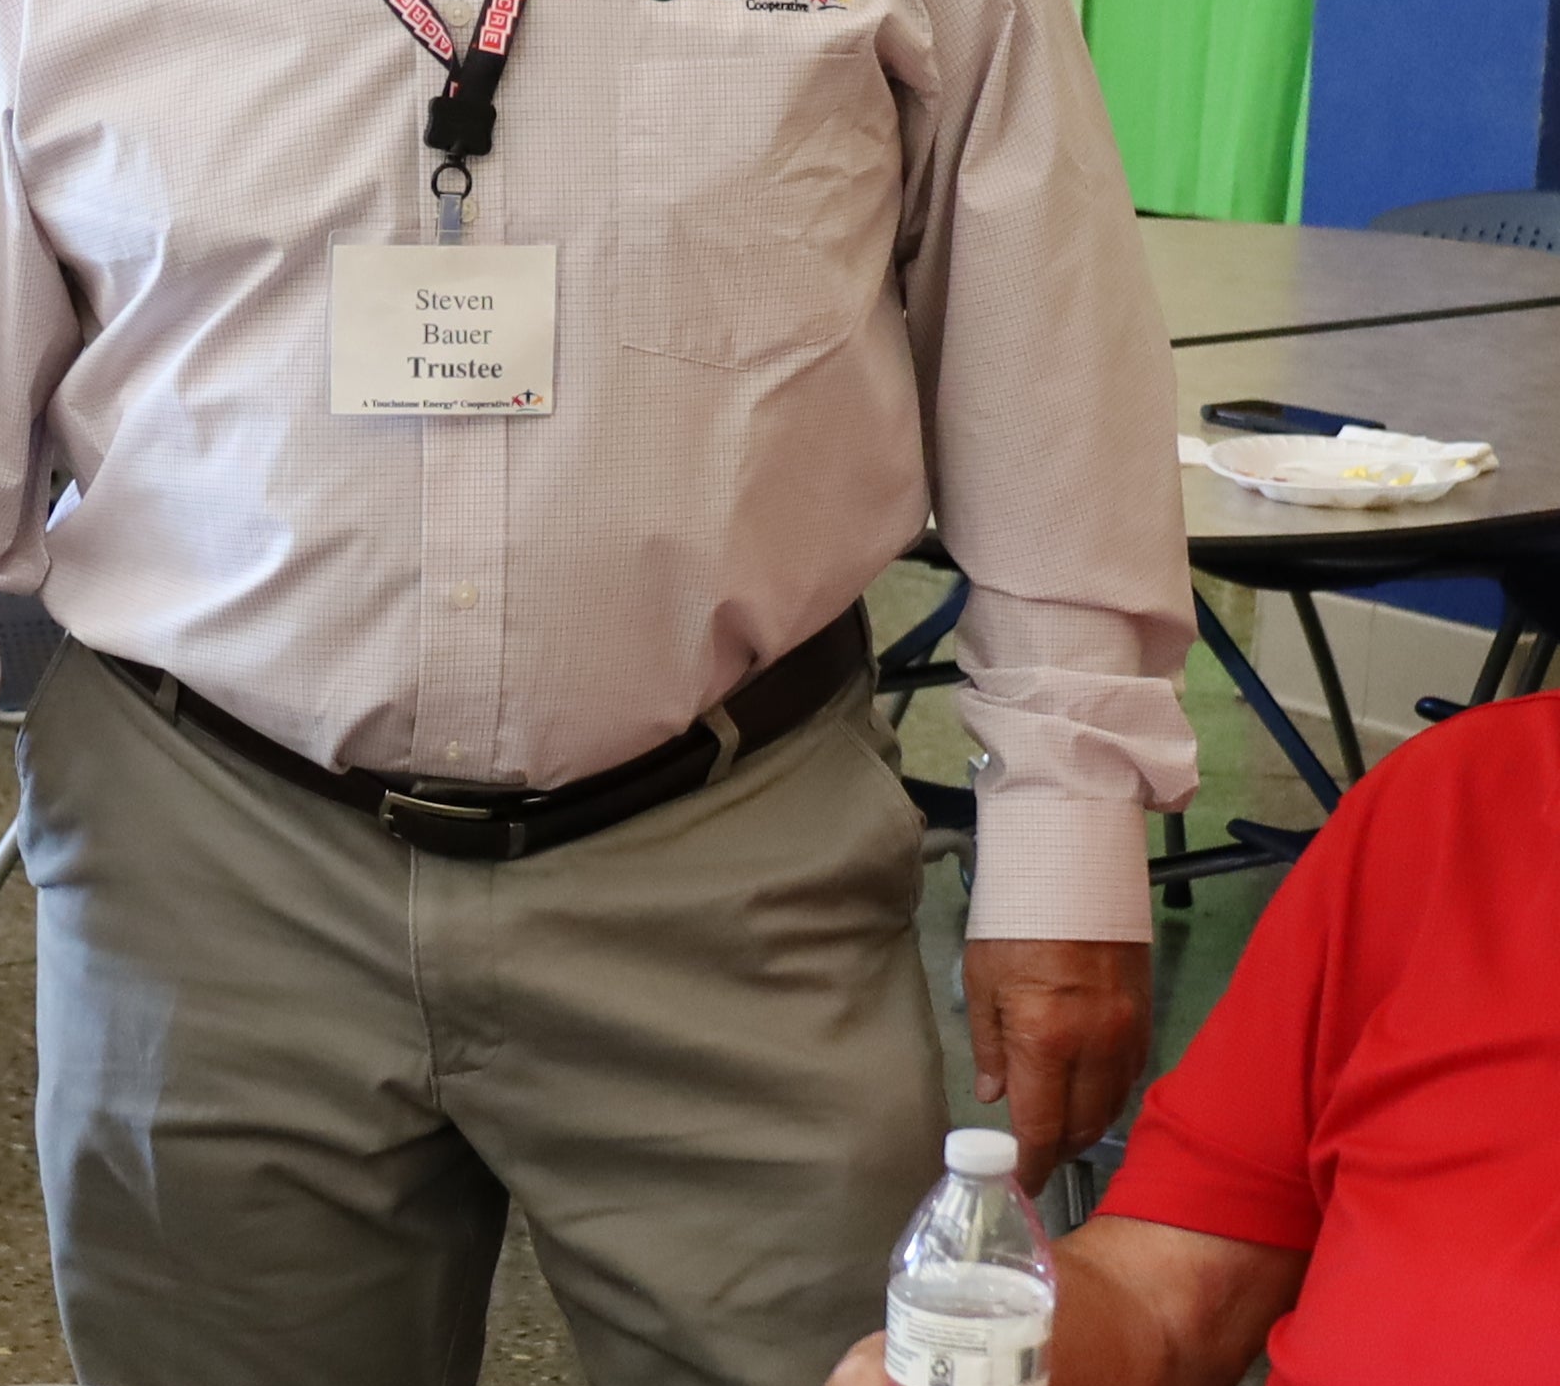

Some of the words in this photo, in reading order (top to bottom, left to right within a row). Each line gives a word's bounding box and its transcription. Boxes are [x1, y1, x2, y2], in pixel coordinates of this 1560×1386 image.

[746, 0, 809, 12] Cooperative
[415, 288, 494, 311] Steven
[423, 323, 492, 345] Bauer
[407, 356, 503, 379] Trustee
[371, 399, 420, 408] Touchstone
[460, 399, 511, 410] Cooperative
